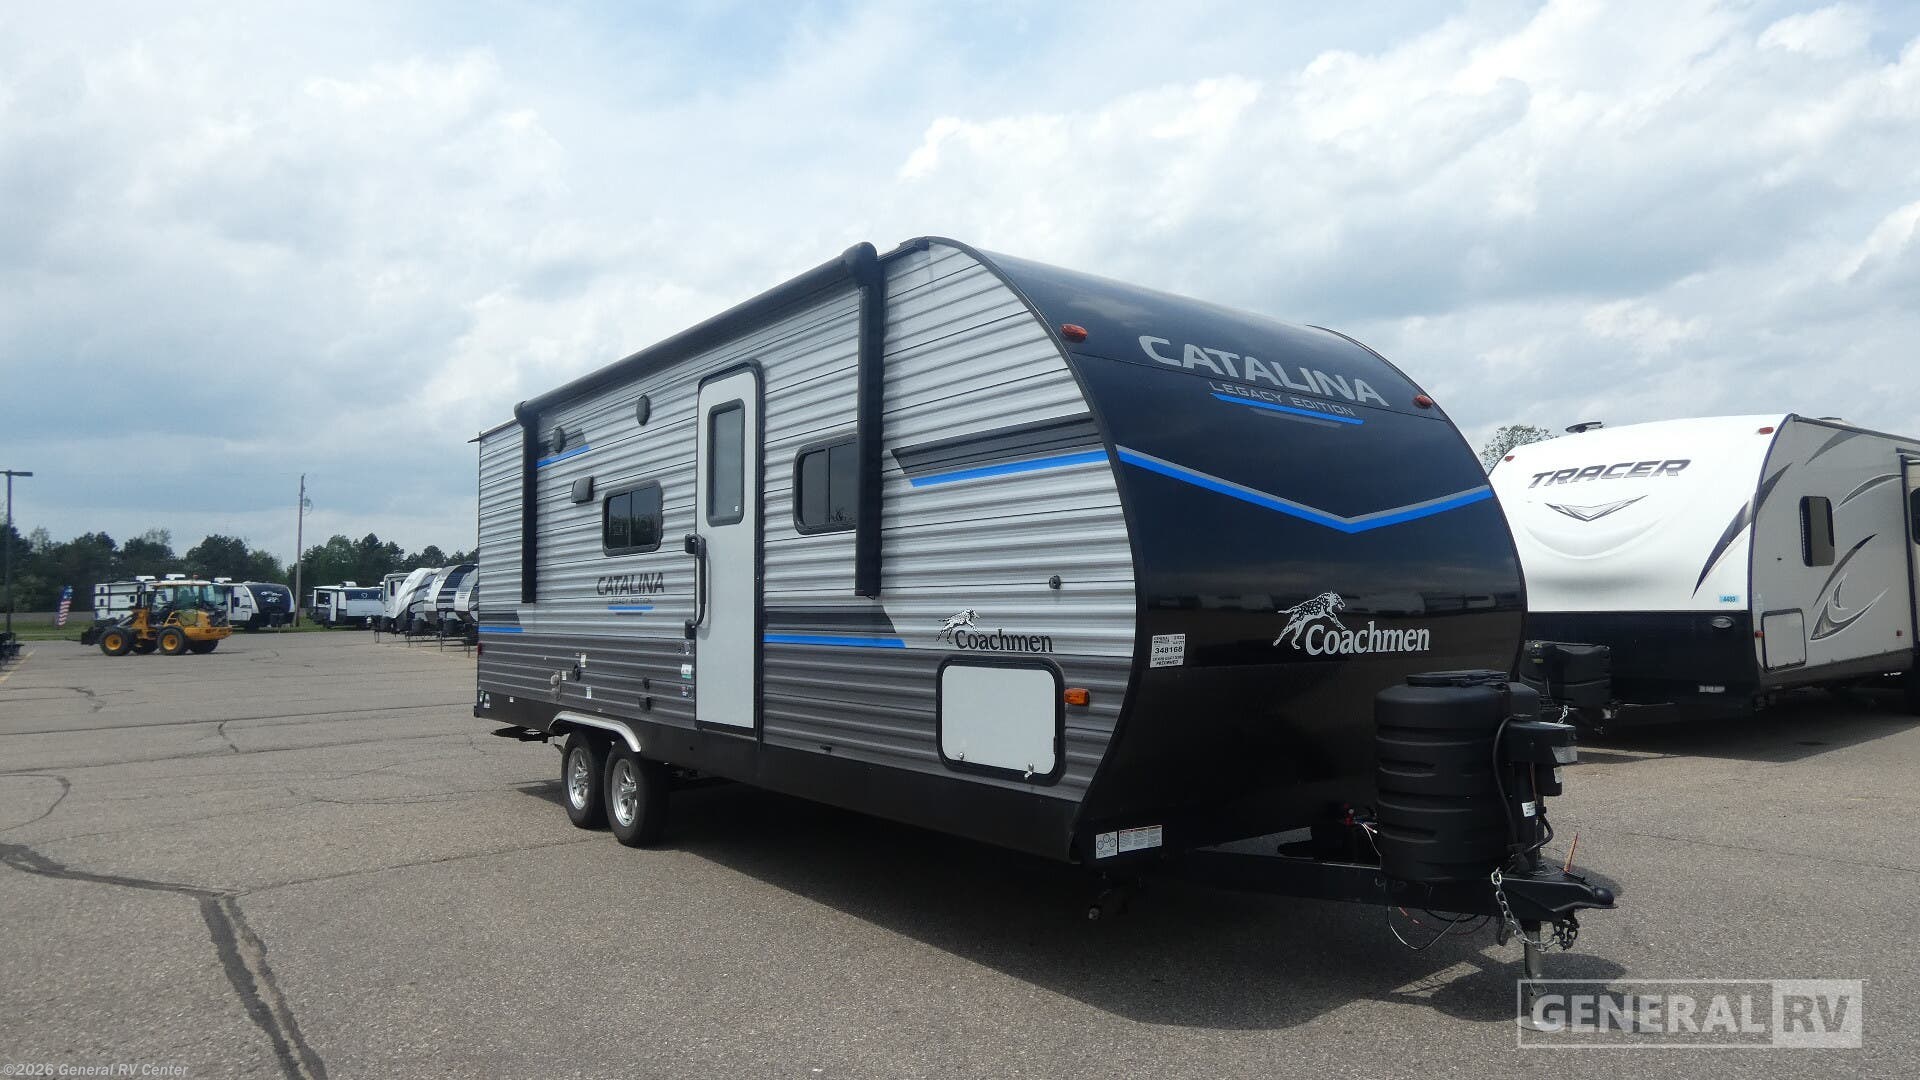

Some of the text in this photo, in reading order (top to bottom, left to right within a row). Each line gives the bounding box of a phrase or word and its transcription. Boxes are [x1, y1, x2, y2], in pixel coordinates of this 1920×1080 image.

[1138, 335, 1390, 407] CATALINA
[1208, 381, 1356, 417] LEGACY EDITION
[1528, 459, 1692, 489] TRACER
[596, 571, 665, 596] CATALINA
[954, 628, 1054, 653] Coachmen
[1305, 620, 1431, 656] Coachmen
